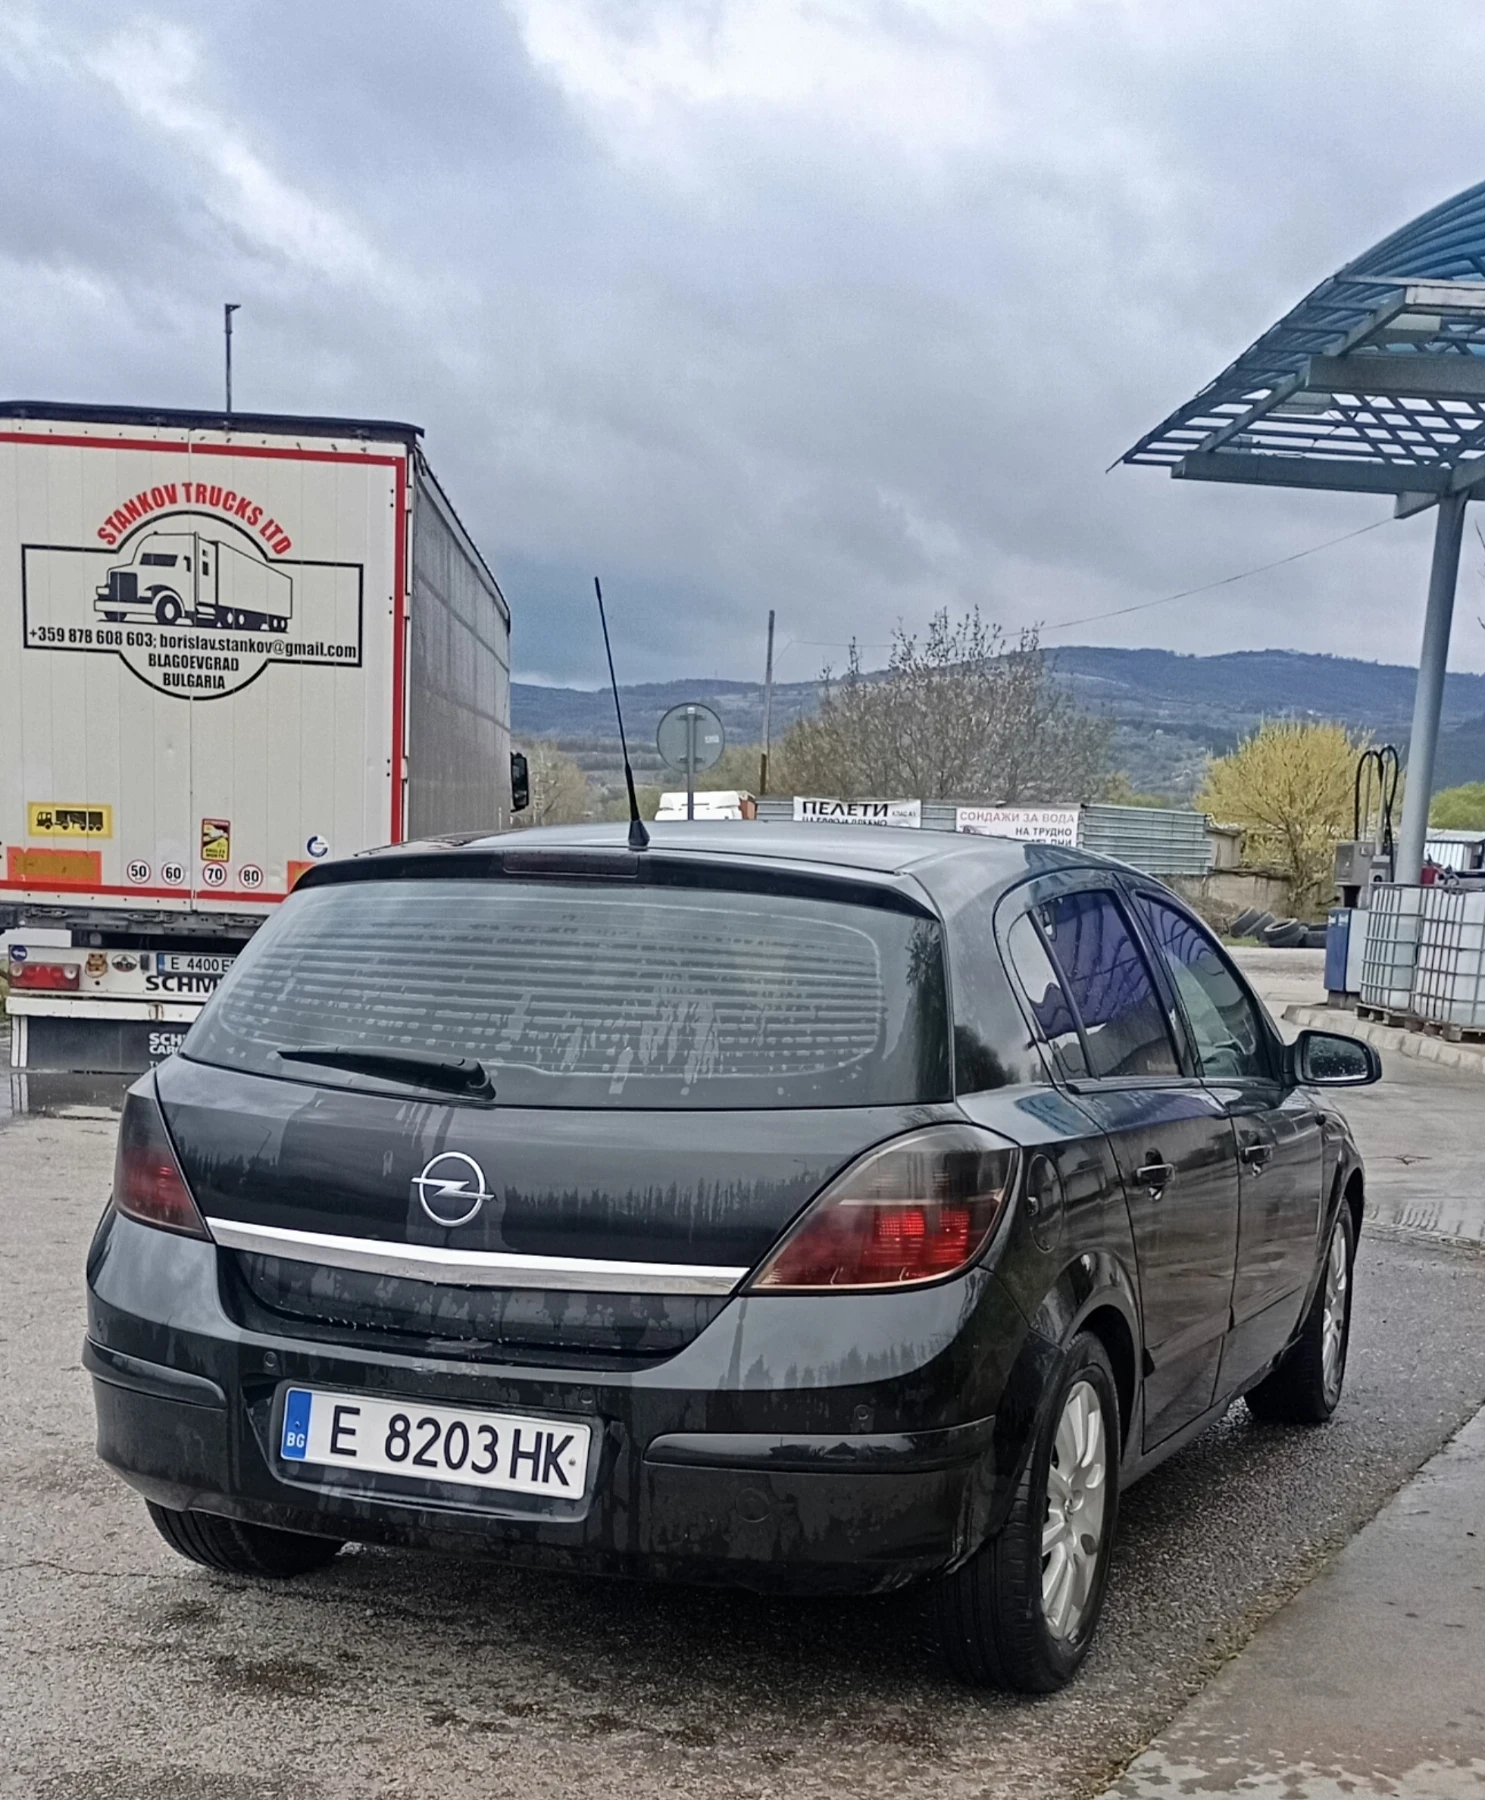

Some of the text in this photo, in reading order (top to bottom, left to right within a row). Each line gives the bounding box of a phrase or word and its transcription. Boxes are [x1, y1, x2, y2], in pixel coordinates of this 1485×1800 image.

[97, 482, 292, 555] STANKOV TRUCKS LTD
[29, 626, 65, 642] +359
[68, 628, 93, 644] 878
[96, 630, 123, 645] 608
[160, 633, 357, 658] borislav.stankov@gmail.com
[148, 653, 239, 671] BLAGOEVGRAD
[163, 672, 226, 689] BULGARIA
[802, 800, 889, 817] ПЕЛЕТИ
[960, 811, 1075, 824] СОНДАЖИ ЗА ВОДА
[1015, 827, 1072, 837] НА ТРУДНО
[131, 865, 147, 877] 50
[166, 867, 181, 879] 60
[207, 868, 222, 880] 70
[243, 870, 259, 882] 80
[171, 957, 234, 972] E 4400 E
[146, 975, 218, 993] SCHM
[149, 1032, 186, 1046] SCH
[286, 1433, 305, 1448] BG
[330, 1404, 575, 1486] E 8203 HK
